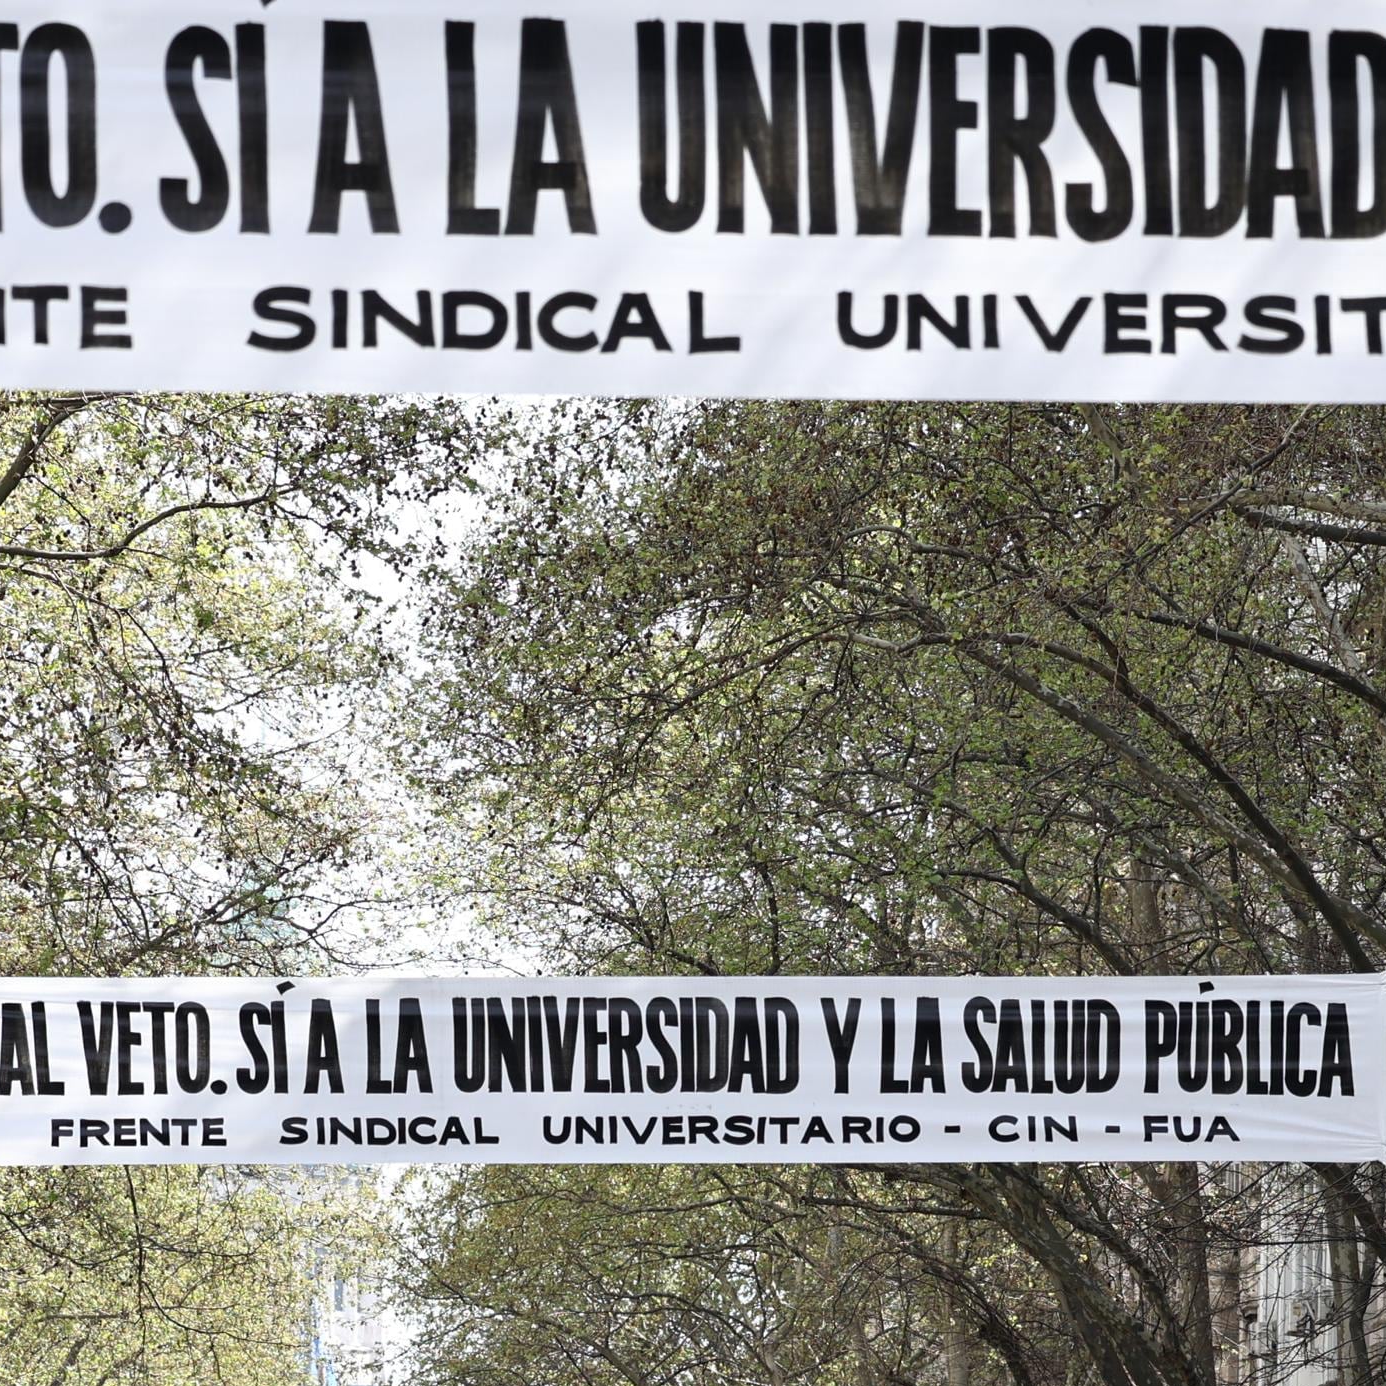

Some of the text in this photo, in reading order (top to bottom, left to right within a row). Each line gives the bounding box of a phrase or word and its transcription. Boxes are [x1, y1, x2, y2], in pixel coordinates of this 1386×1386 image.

[308, 20, 399, 234] A
[445, 17, 597, 235] LA
[247, 286, 740, 354] SINDICAL
[77, 1001, 227, 1095] VETO.
[236, 981, 295, 1094] SÍ
[304, 999, 344, 1094] A
[366, 998, 433, 1094] LA
[452, 996, 799, 1094] UNIVERSIDAD
[821, 998, 861, 1094] Y
[880, 997, 946, 1093] LA
[962, 996, 1120, 1094] SALUD
[1144, 981, 1354, 1097] PÚBLICA
[51, 1118, 227, 1147] FRENTE
[280, 1117, 499, 1145] SINDICAL
[543, 1115, 920, 1145] UNIVERSITARIO
[989, 1115, 1078, 1142] CIN
[1144, 1116, 1240, 1142] FUA
